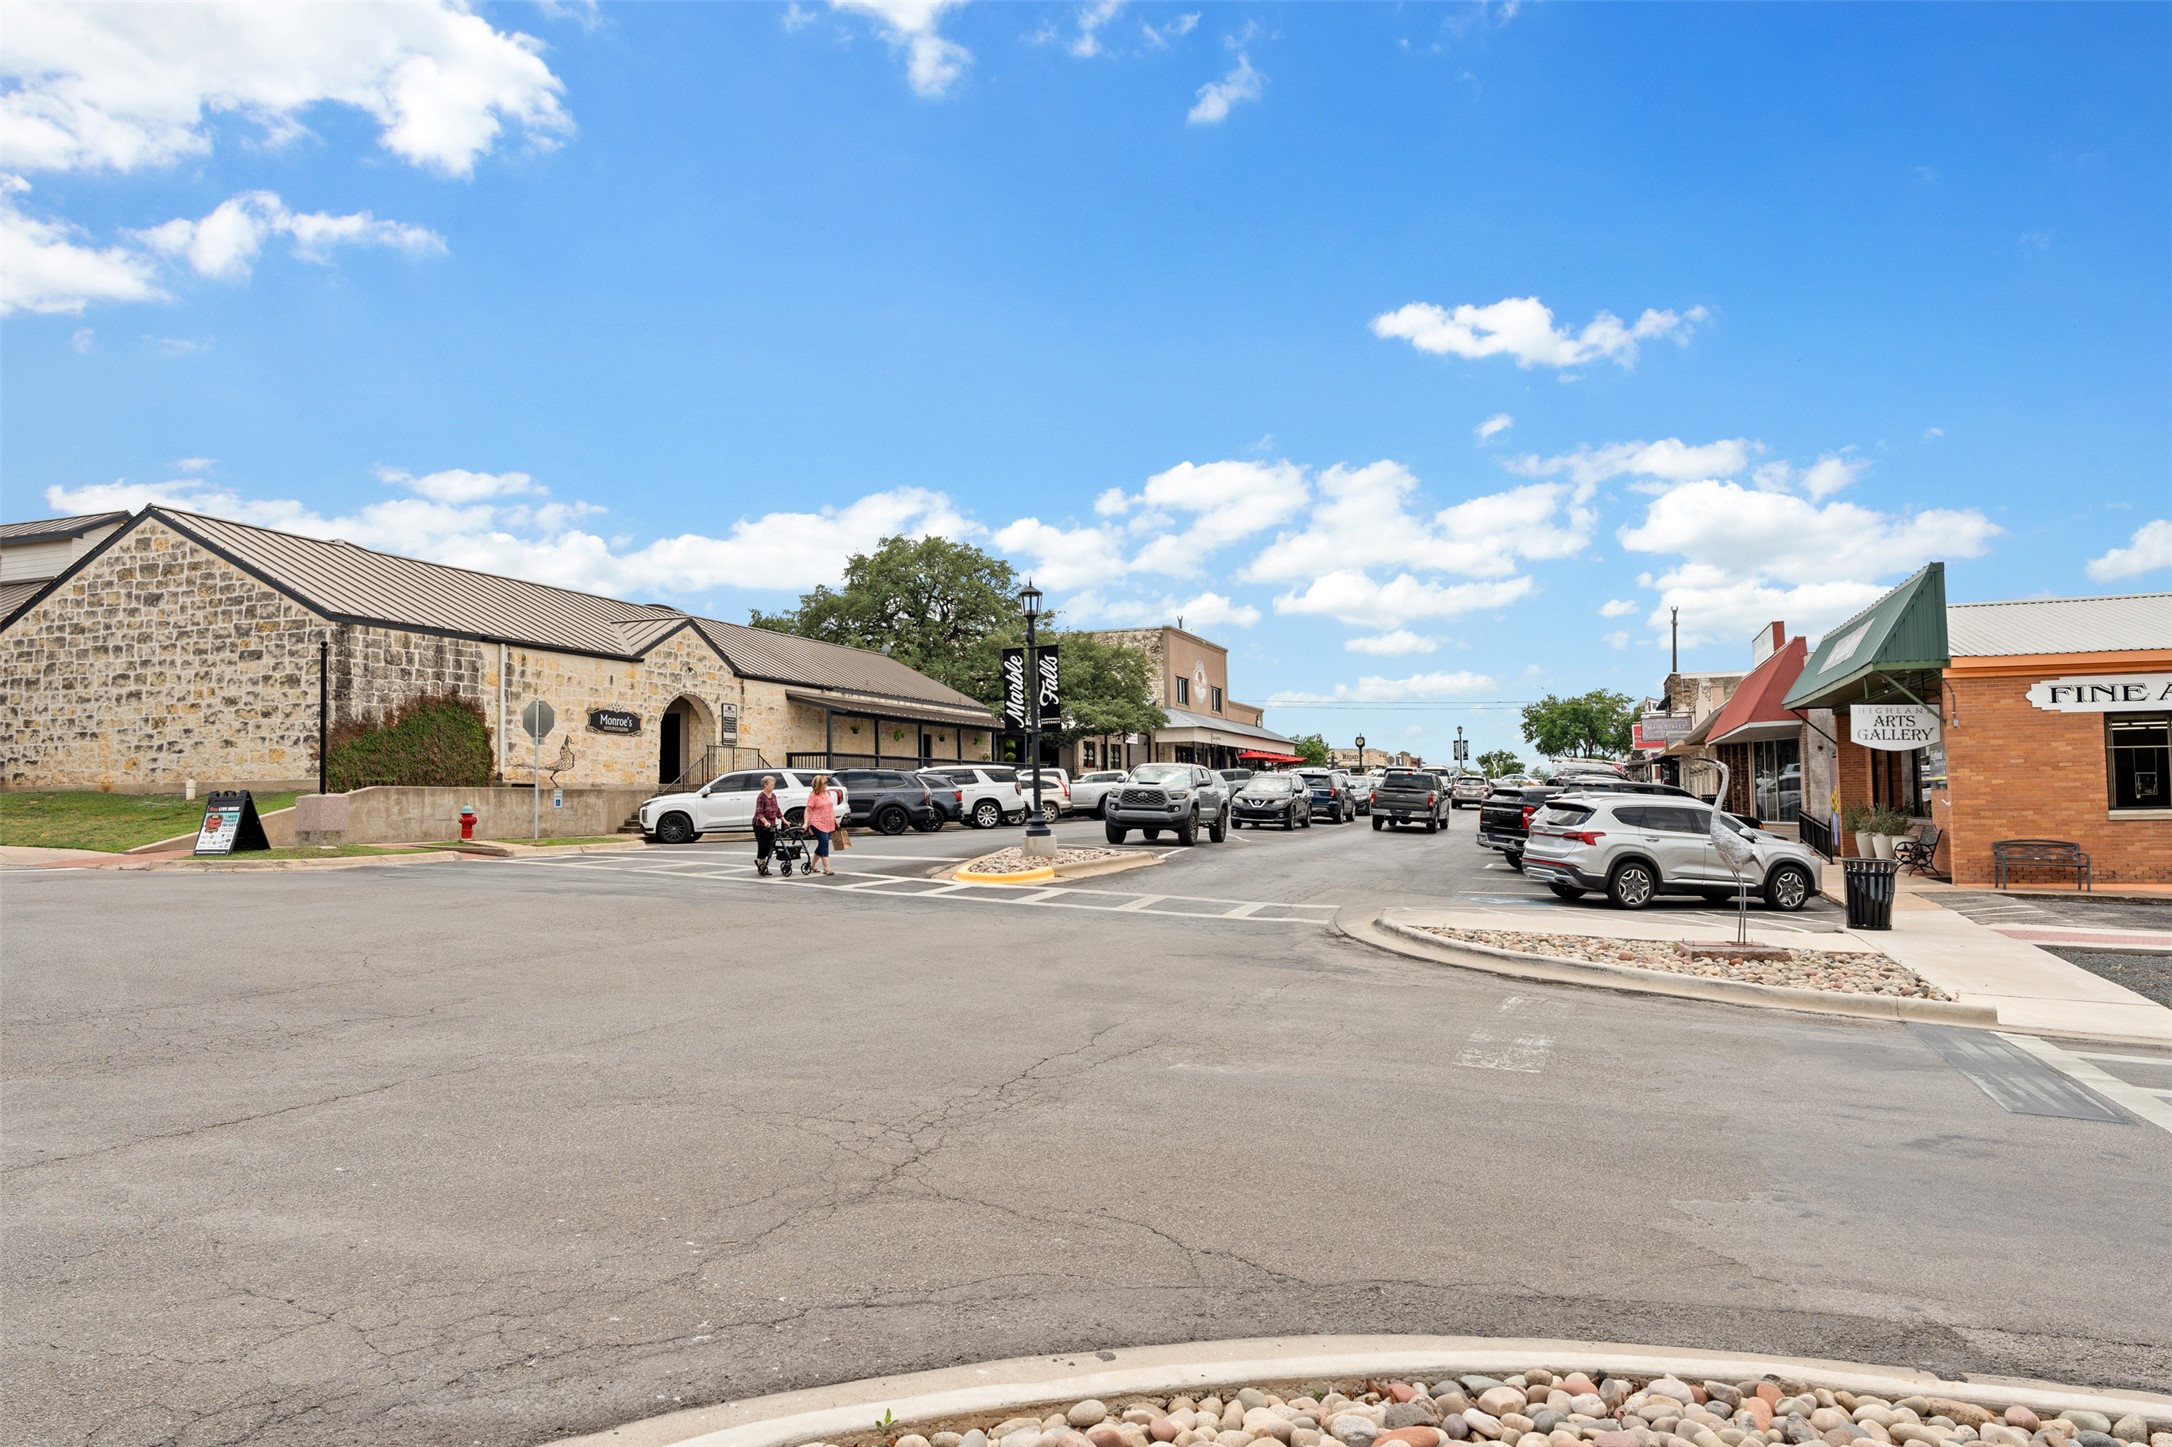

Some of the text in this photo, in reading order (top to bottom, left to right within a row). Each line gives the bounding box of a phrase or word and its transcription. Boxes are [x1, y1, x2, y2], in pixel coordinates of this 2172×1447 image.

[1039, 654, 1060, 707] Falls
[1004, 655, 1025, 728] Marble
[2048, 682, 2150, 704] FINE
[600, 714, 632, 727] Monroe's
[1873, 715, 1916, 727] ARTS
[1857, 727, 1935, 741] GALLERY
